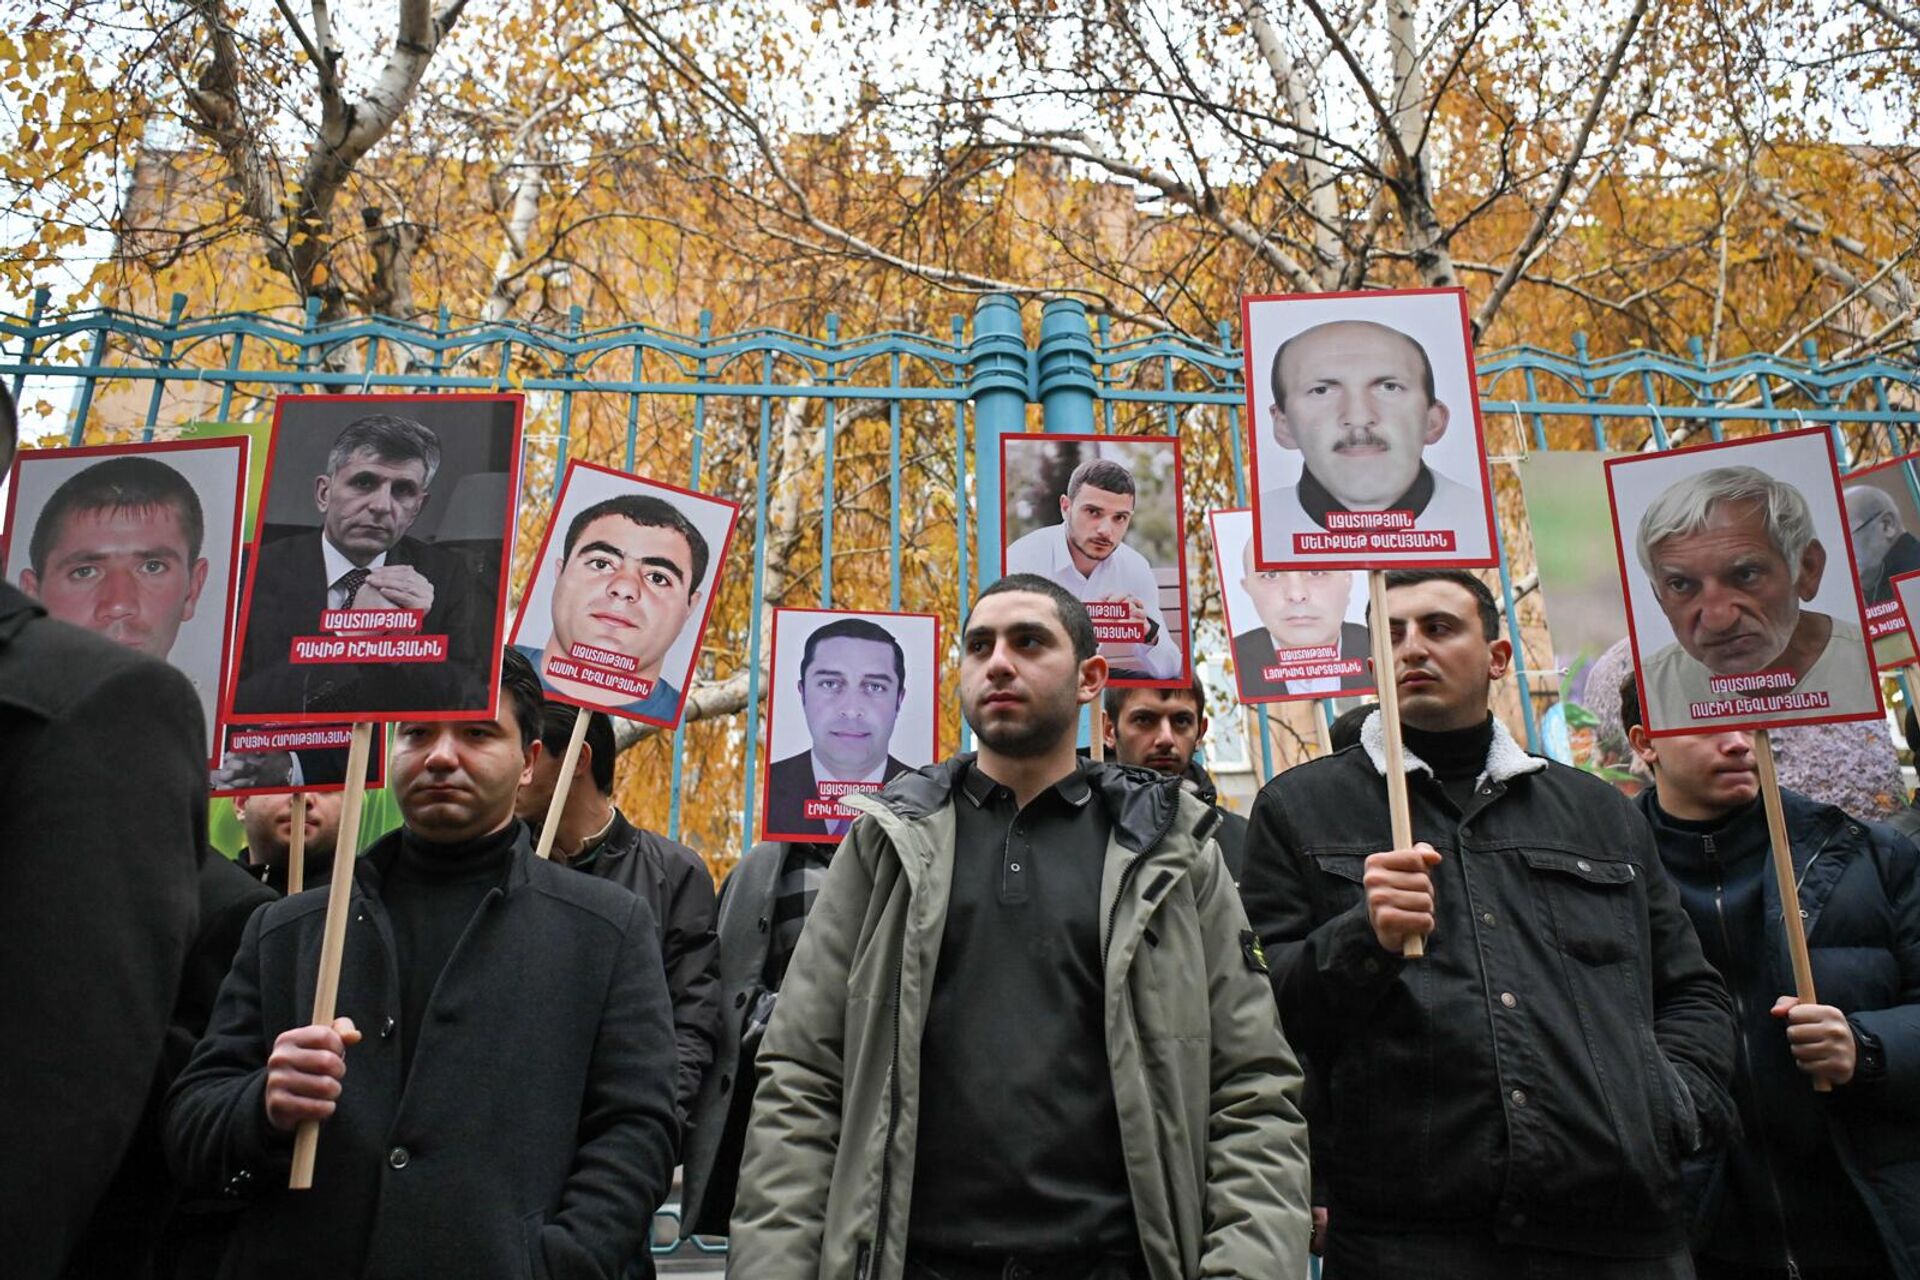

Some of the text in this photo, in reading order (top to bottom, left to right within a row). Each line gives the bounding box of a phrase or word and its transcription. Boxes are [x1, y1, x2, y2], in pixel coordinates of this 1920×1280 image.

[1328, 513, 1412, 528] ԱԶԱՏՈՒԹՅՈՒՆ
[1300, 534, 1448, 549] ՄԵԼԻՔՍԵԹ ՓԱՇԱՅԱՆԻՆ
[324, 612, 417, 629] ԱԶԱՏՈՒԹՅՈՒՆ
[296, 640, 442, 658] ԴԱՎԻԹ ԻՇԽԱՆՅԱՆԻՆ
[1280, 647, 1336, 661] ԱԶԱՏՈՒԹՅՈՒՆ
[572, 644, 636, 671] ԱԶԱՏՈՒԹՅՈՒՆ
[548, 661, 649, 695] ՎԱՍԻԼ ԲԵԳԼԱՐՅԱՆԻՆ
[1711, 672, 1796, 693] ԱԶԱՏՈՒԹՅՈՒՆ
[1692, 693, 1828, 717] ՌԱՇԻԴ ԲԵԳԼԱՐՅԱՆԻՆ
[233, 735, 270, 749] ԱՐԱՅԻԿ
[820, 783, 880, 796] ԱԶԱՏՈՒԹՅՈՒ
[808, 803, 832, 816] ԷՐԻԿ
